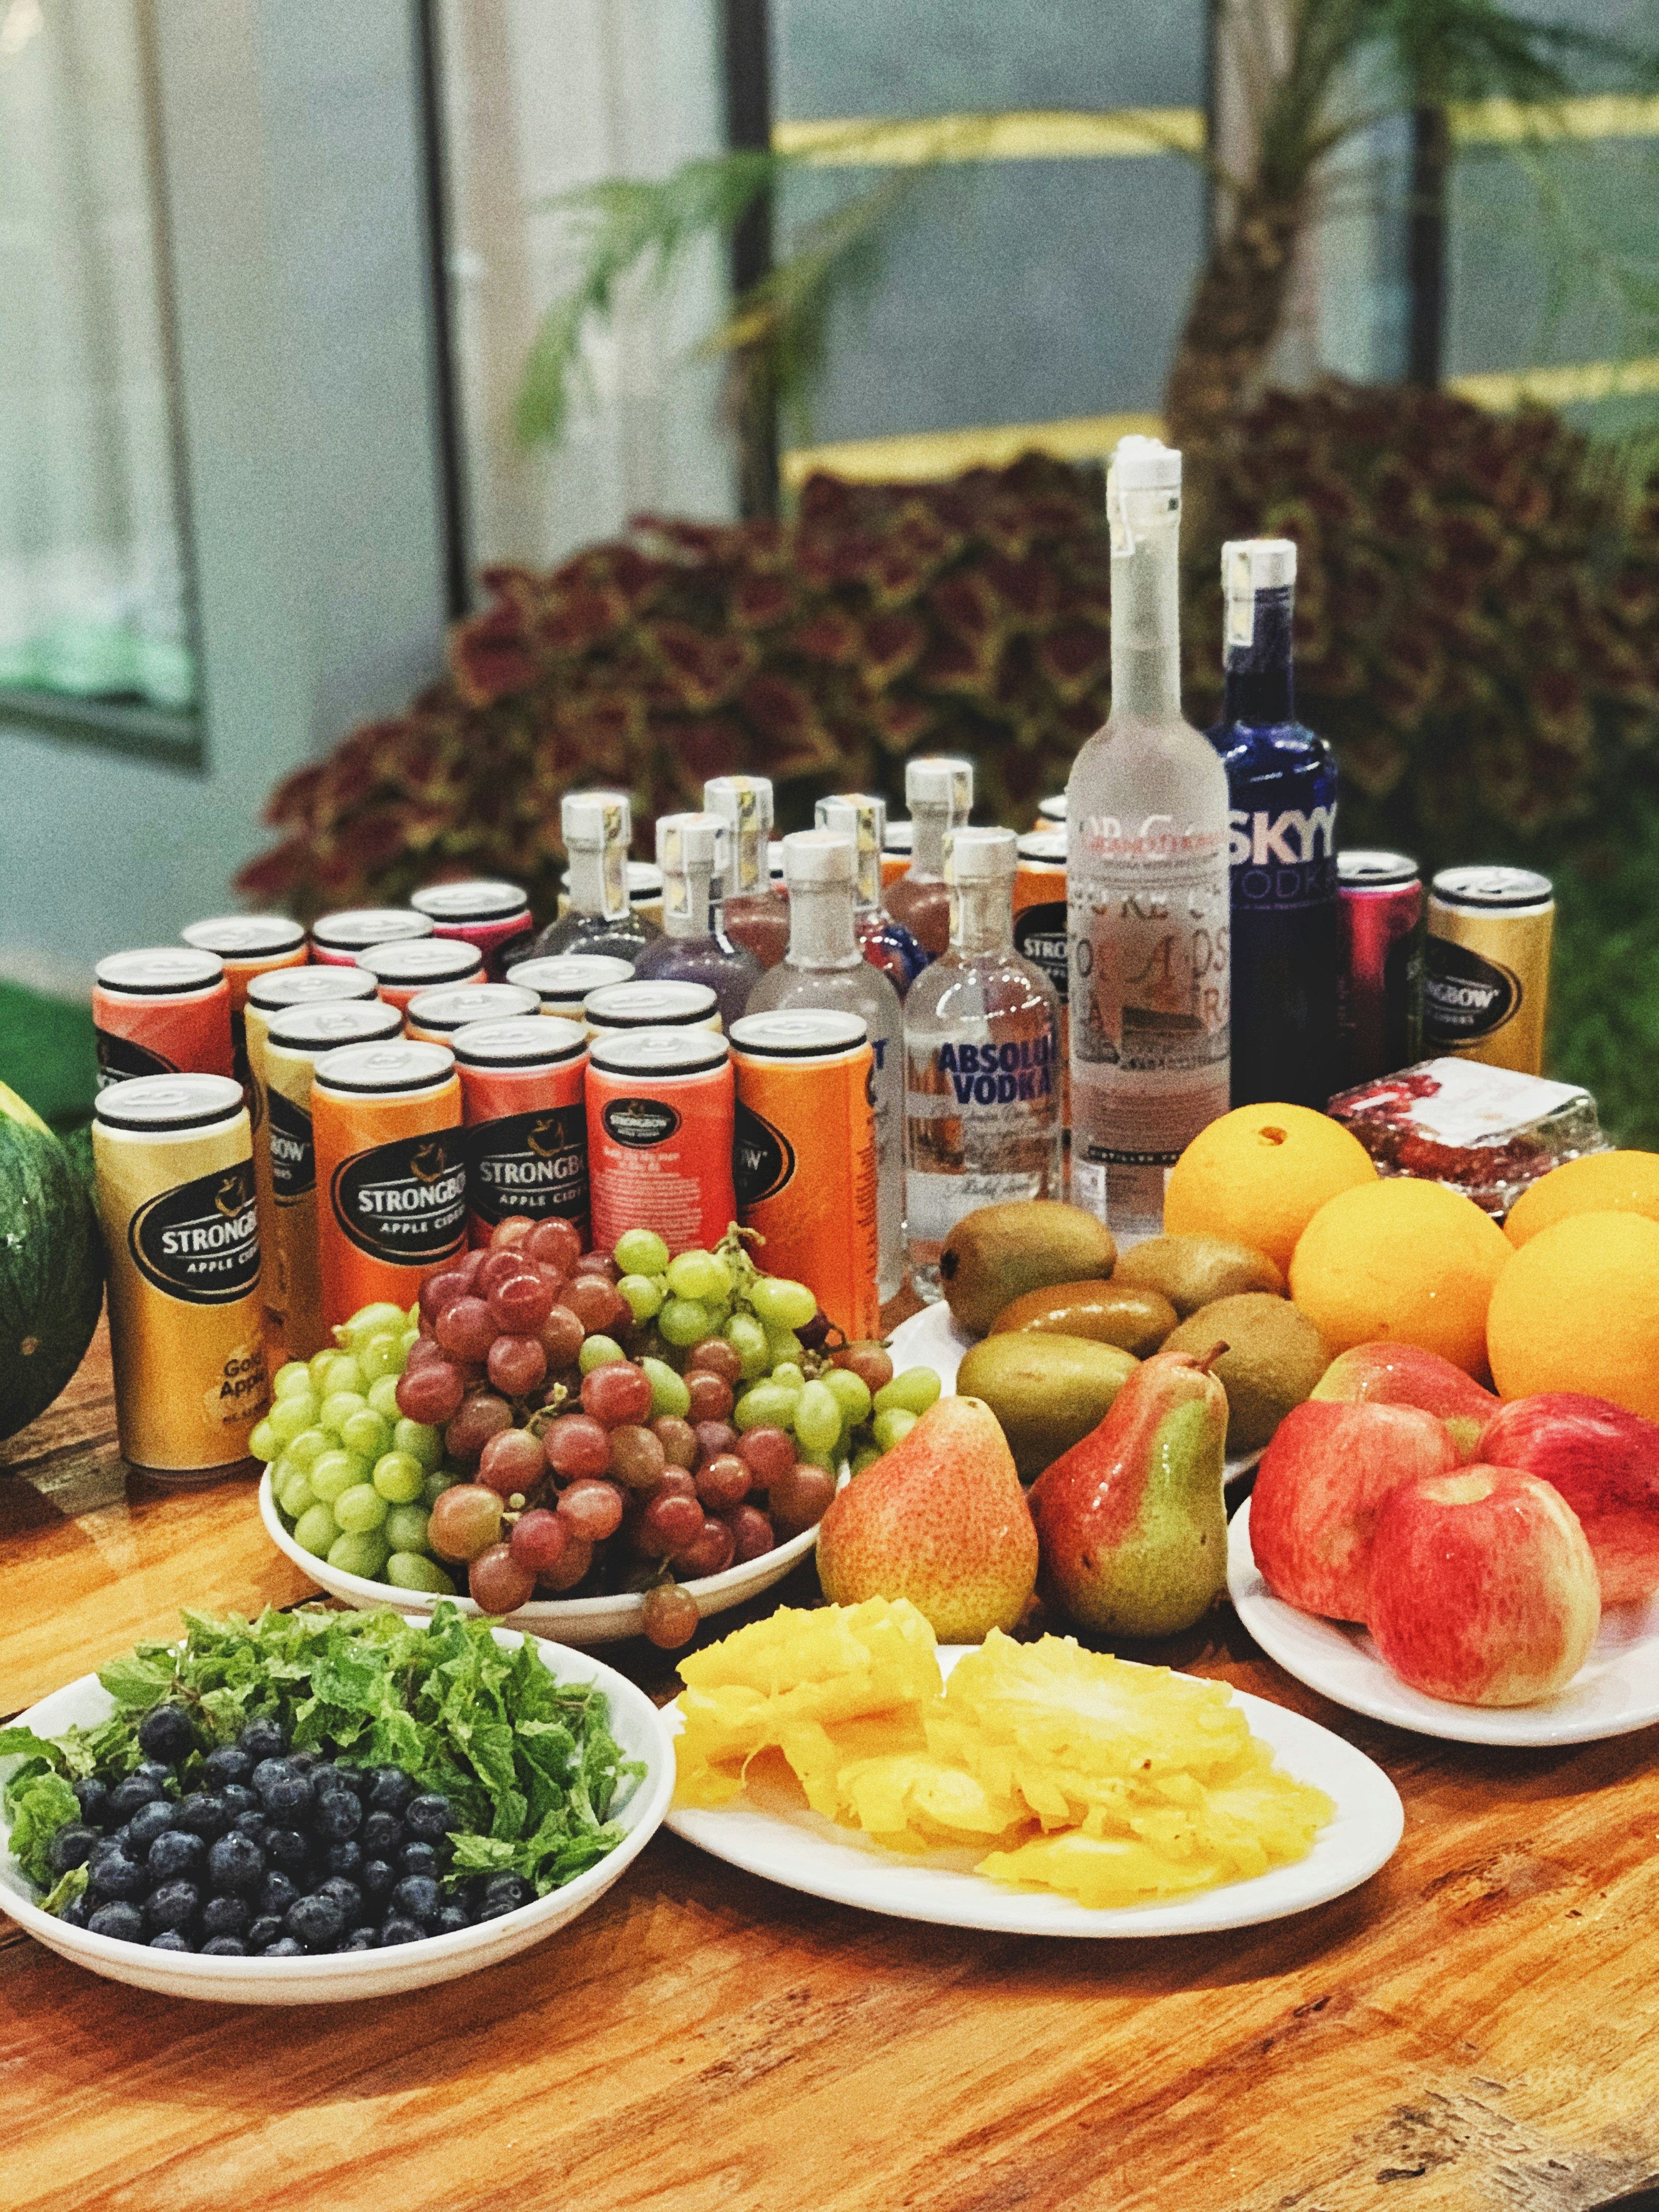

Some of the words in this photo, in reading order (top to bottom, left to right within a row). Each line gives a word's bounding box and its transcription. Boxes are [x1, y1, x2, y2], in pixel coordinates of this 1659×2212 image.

[1229, 801, 1337, 865] SKYY
[1237, 868, 1333, 900] ODK
[1024, 938, 1065, 957] STRO
[953, 1066, 1051, 1105] VODKA
[479, 1154, 584, 1184] STRONGB
[358, 1172, 466, 1212] STRONGBO
[500, 1194, 546, 1207] APPLE
[162, 1210, 257, 1254] STRONGB
[380, 1222, 428, 1233] APPLE
[187, 1257, 233, 1273] APPLE
